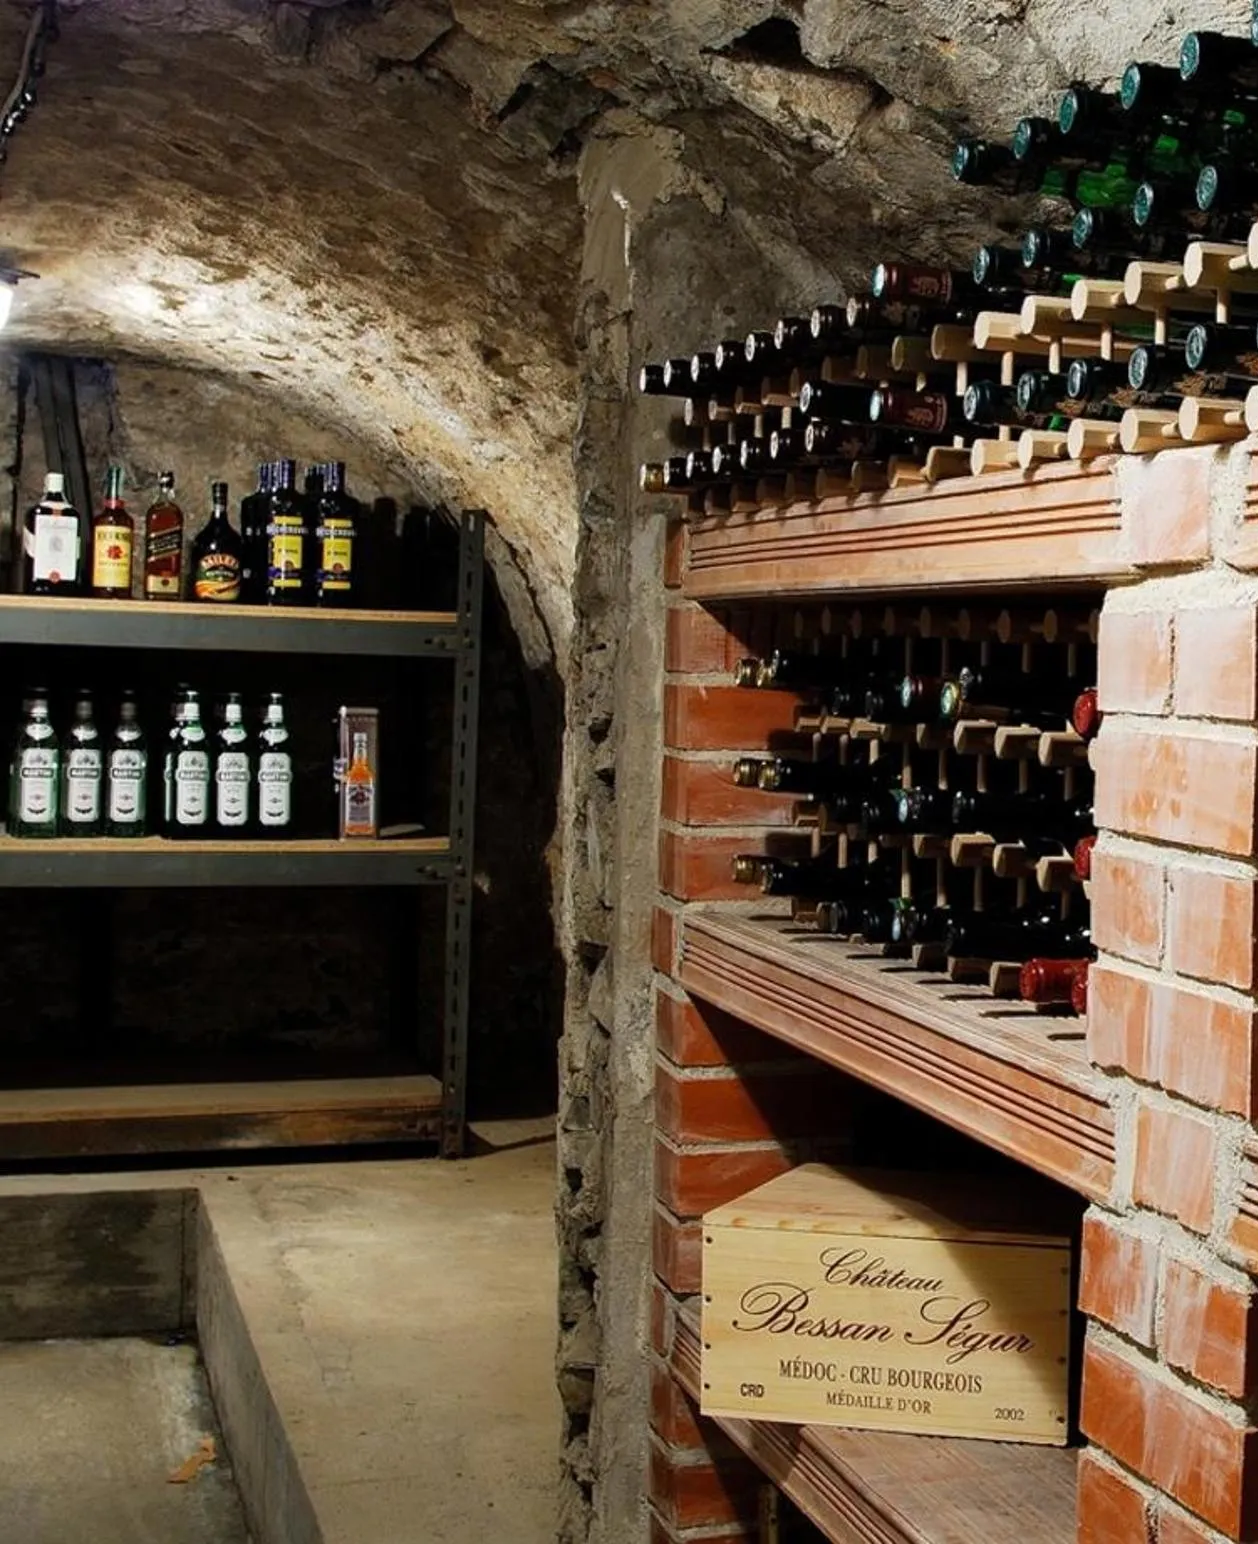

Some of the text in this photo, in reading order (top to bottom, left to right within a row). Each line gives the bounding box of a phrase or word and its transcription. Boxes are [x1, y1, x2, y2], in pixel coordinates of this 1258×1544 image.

[819, 1247, 944, 1292] Château
[732, 1281, 1035, 1365] Bessan Ségur
[779, 1355, 837, 1382] MÉDOC
[849, 1365, 881, 1385] CRU
[887, 1370, 983, 1394] BOURGEOIS
[826, 1388, 932, 1415] MÉDAILLE D'OR
[994, 1407, 1025, 1421] 2002
